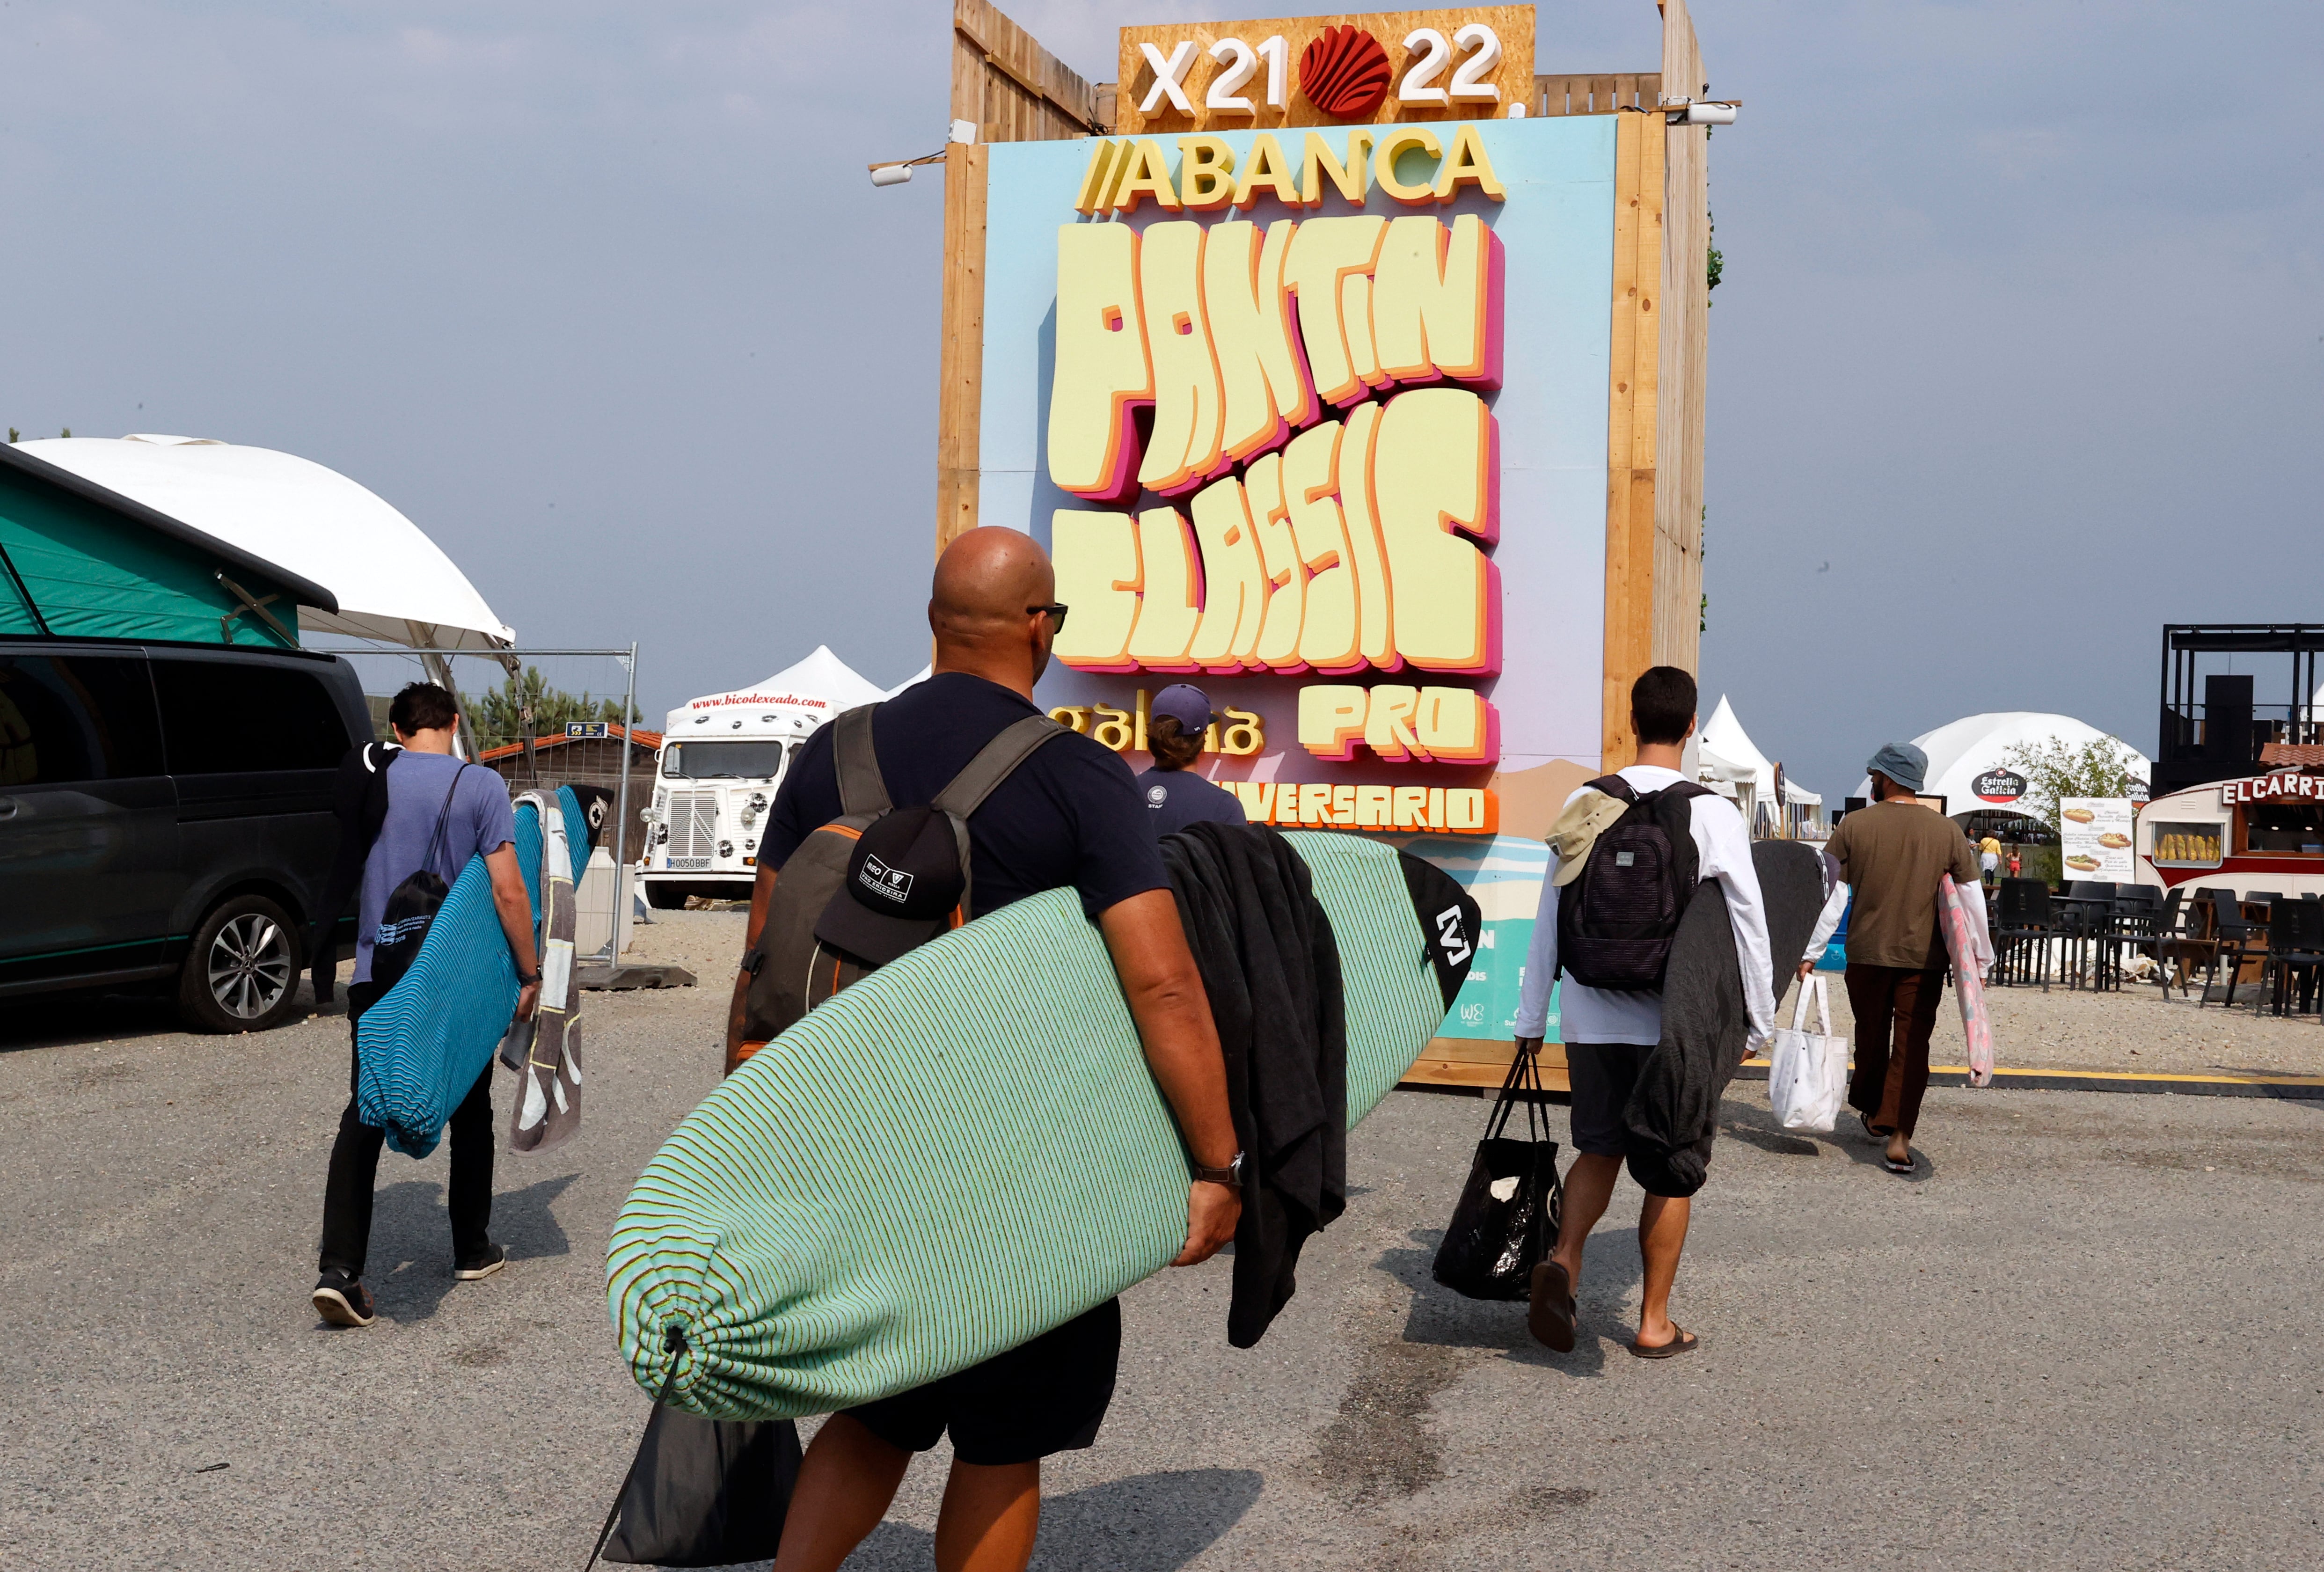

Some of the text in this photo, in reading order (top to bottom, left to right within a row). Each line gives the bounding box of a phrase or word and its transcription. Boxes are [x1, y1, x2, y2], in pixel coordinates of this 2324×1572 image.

[1398, 23, 1501, 109] 22
[1052, 388, 1500, 674] CLASSIC
[693, 694, 827, 709] www.bicodexeado.com
[1298, 685, 1493, 760] PRO
[1981, 776, 2018, 786] Estrella
[1981, 785, 2016, 795] Galicia
[1210, 781, 1493, 831] VERSARIO
[866, 862, 882, 875] MEO
[872, 882, 903, 898] ERICEIRA
[1466, 972, 1487, 981] DIS
